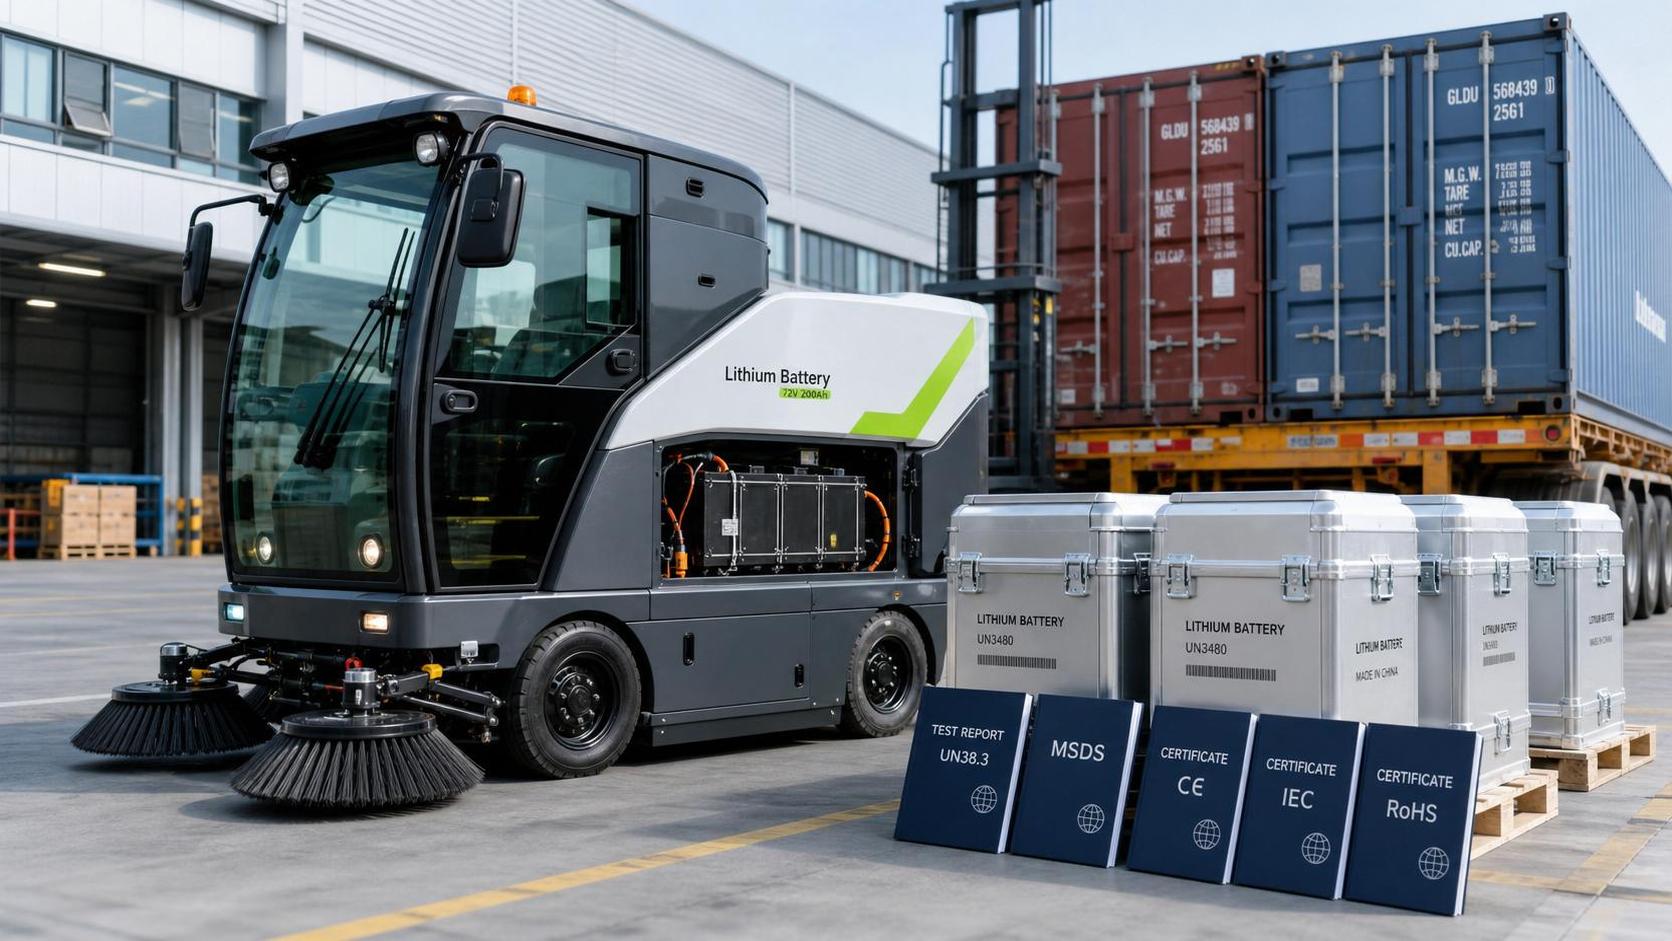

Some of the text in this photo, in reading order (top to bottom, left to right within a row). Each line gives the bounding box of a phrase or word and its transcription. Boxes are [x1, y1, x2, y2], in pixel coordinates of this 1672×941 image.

[1447, 85, 1479, 105] GLDU
[1493, 79, 1538, 100] 568439
[1161, 122, 1188, 140] GLDU
[1444, 165, 1482, 184] M.G.W.
[1444, 184, 1470, 202] TARE
[1445, 218, 1466, 236] NET
[1445, 239, 1484, 258] CU.CAP.
[725, 365, 831, 389] Lithium Battery
[782, 387, 828, 400] 72V 200Ah
[976, 613, 1065, 628] LITHIUM BATTERY
[1185, 620, 1286, 636] LITHIUM BATTERY
[977, 633, 1014, 646] UN3480
[1185, 641, 1228, 656] UN3480
[1355, 640, 1379, 655] LITHIUM
[1355, 669, 1374, 682] MADE
[932, 723, 1005, 742] TEST REPORT
[939, 748, 989, 767] UN38.3
[1050, 739, 1106, 763] MSDS
[1160, 746, 1229, 766] CERTIFICATE
[1266, 757, 1337, 777] CERTIFICATE
[1177, 775, 1205, 797] CE
[1376, 768, 1453, 789] CERTIFICATE
[1282, 787, 1315, 810] IEC
[1386, 798, 1438, 824] RoHS
